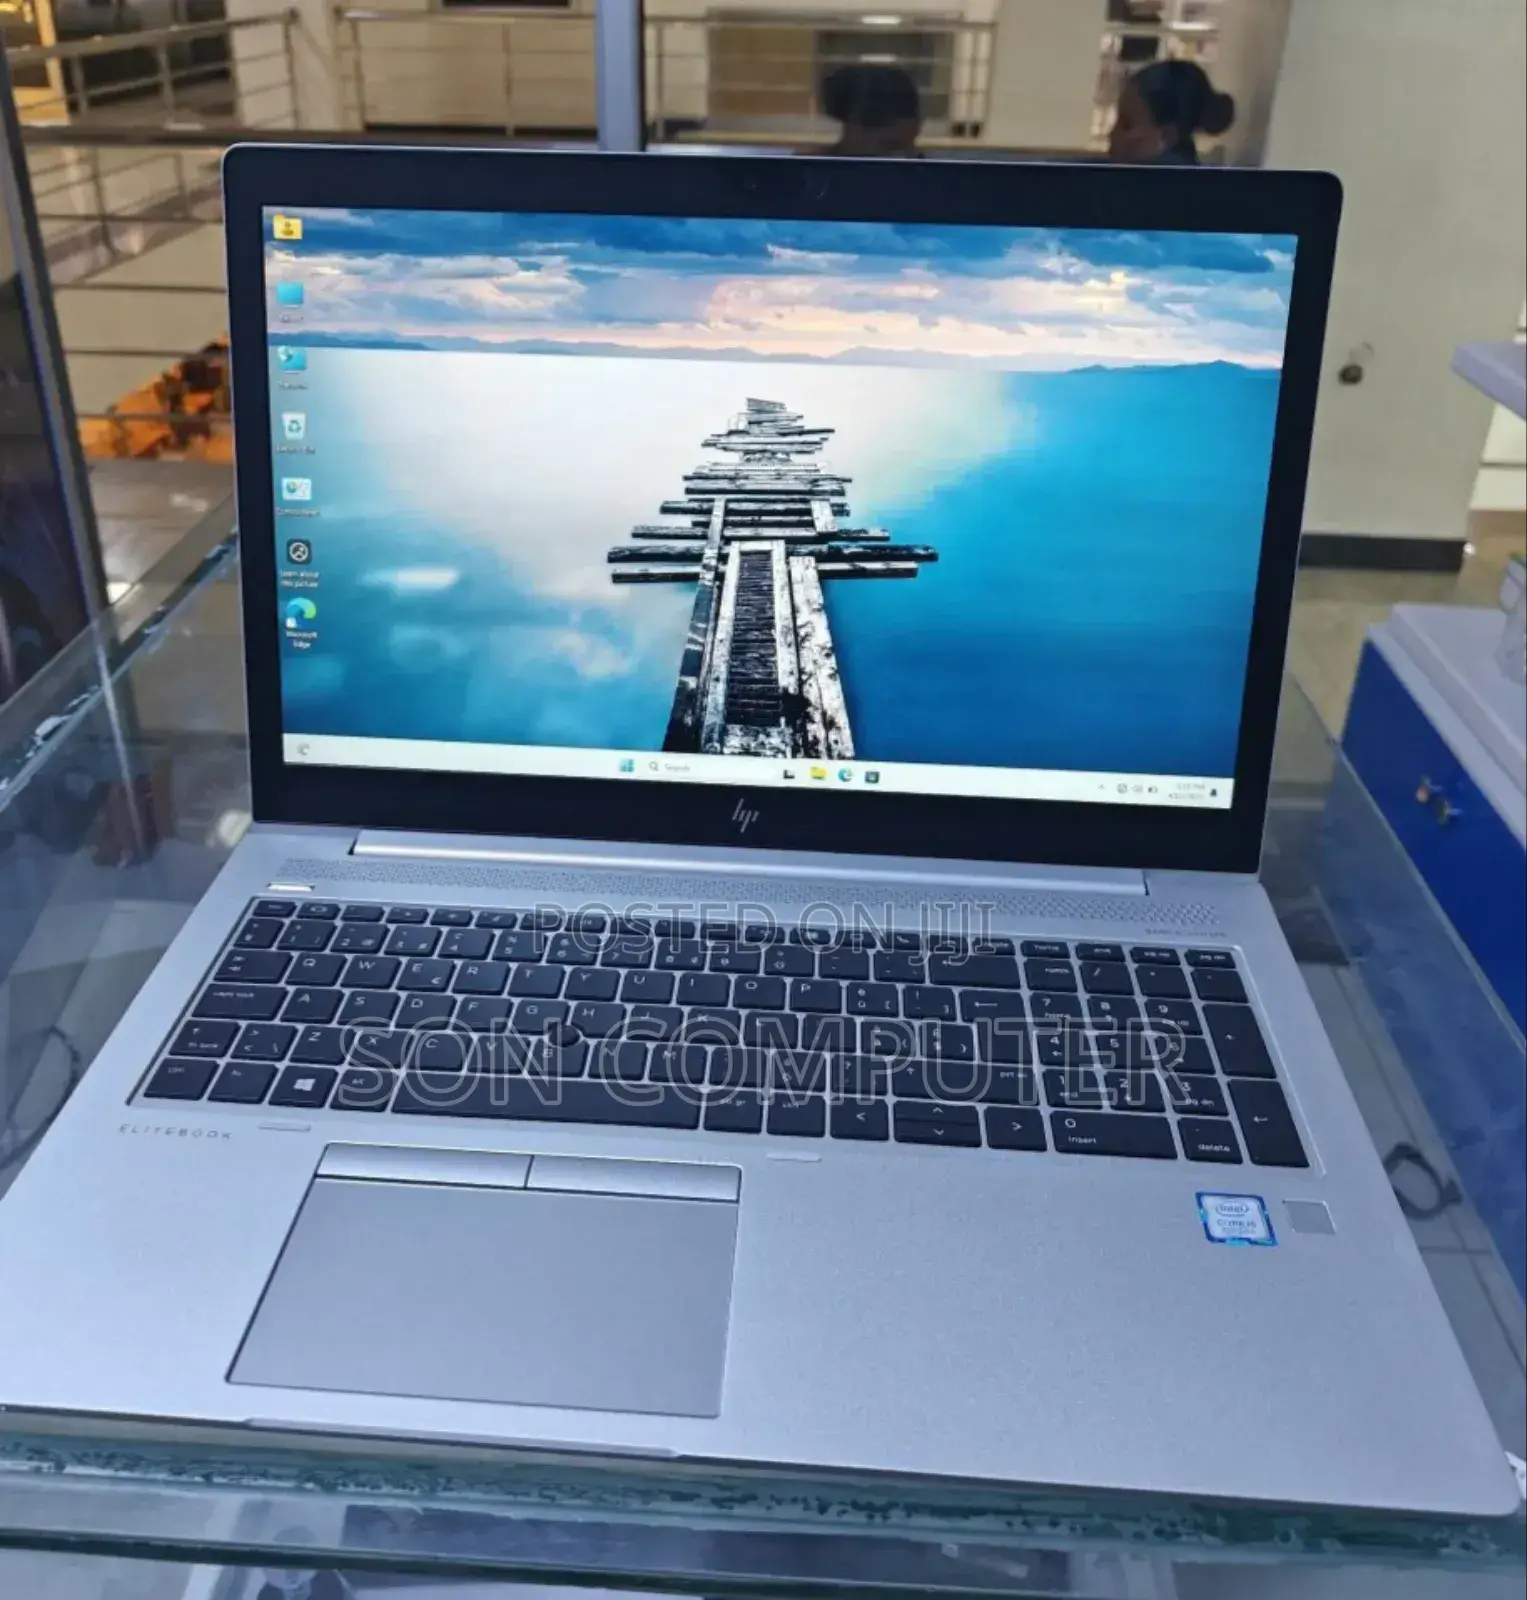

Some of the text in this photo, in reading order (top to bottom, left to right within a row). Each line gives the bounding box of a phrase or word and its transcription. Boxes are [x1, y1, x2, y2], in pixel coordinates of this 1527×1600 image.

[303, 958, 316, 968] Q
[359, 960, 376, 970] W
[412, 963, 424, 972] E
[466, 966, 479, 975] R
[524, 969, 534, 979] T
[580, 973, 592, 981] Y
[634, 975, 646, 984] U
[744, 981, 758, 990] O
[801, 983, 812, 993] P
[300, 994, 310, 1003] A
[355, 997, 366, 1006] S
[411, 999, 424, 1008] D
[468, 1001, 479, 1011] F
[526, 1005, 539, 1015] G
[583, 1007, 595, 1017] H
[308, 1031, 321, 1041] Z
[367, 1036, 379, 1046] X
[1050, 1036, 1060, 1045] 4
[425, 1039, 438, 1049] C
[1109, 1038, 1120, 1048] 5
[1119, 1079, 1130, 1088] 2
[1064, 1118, 1077, 1129] 0
[119, 1123, 233, 1140] ELITEBOOK
